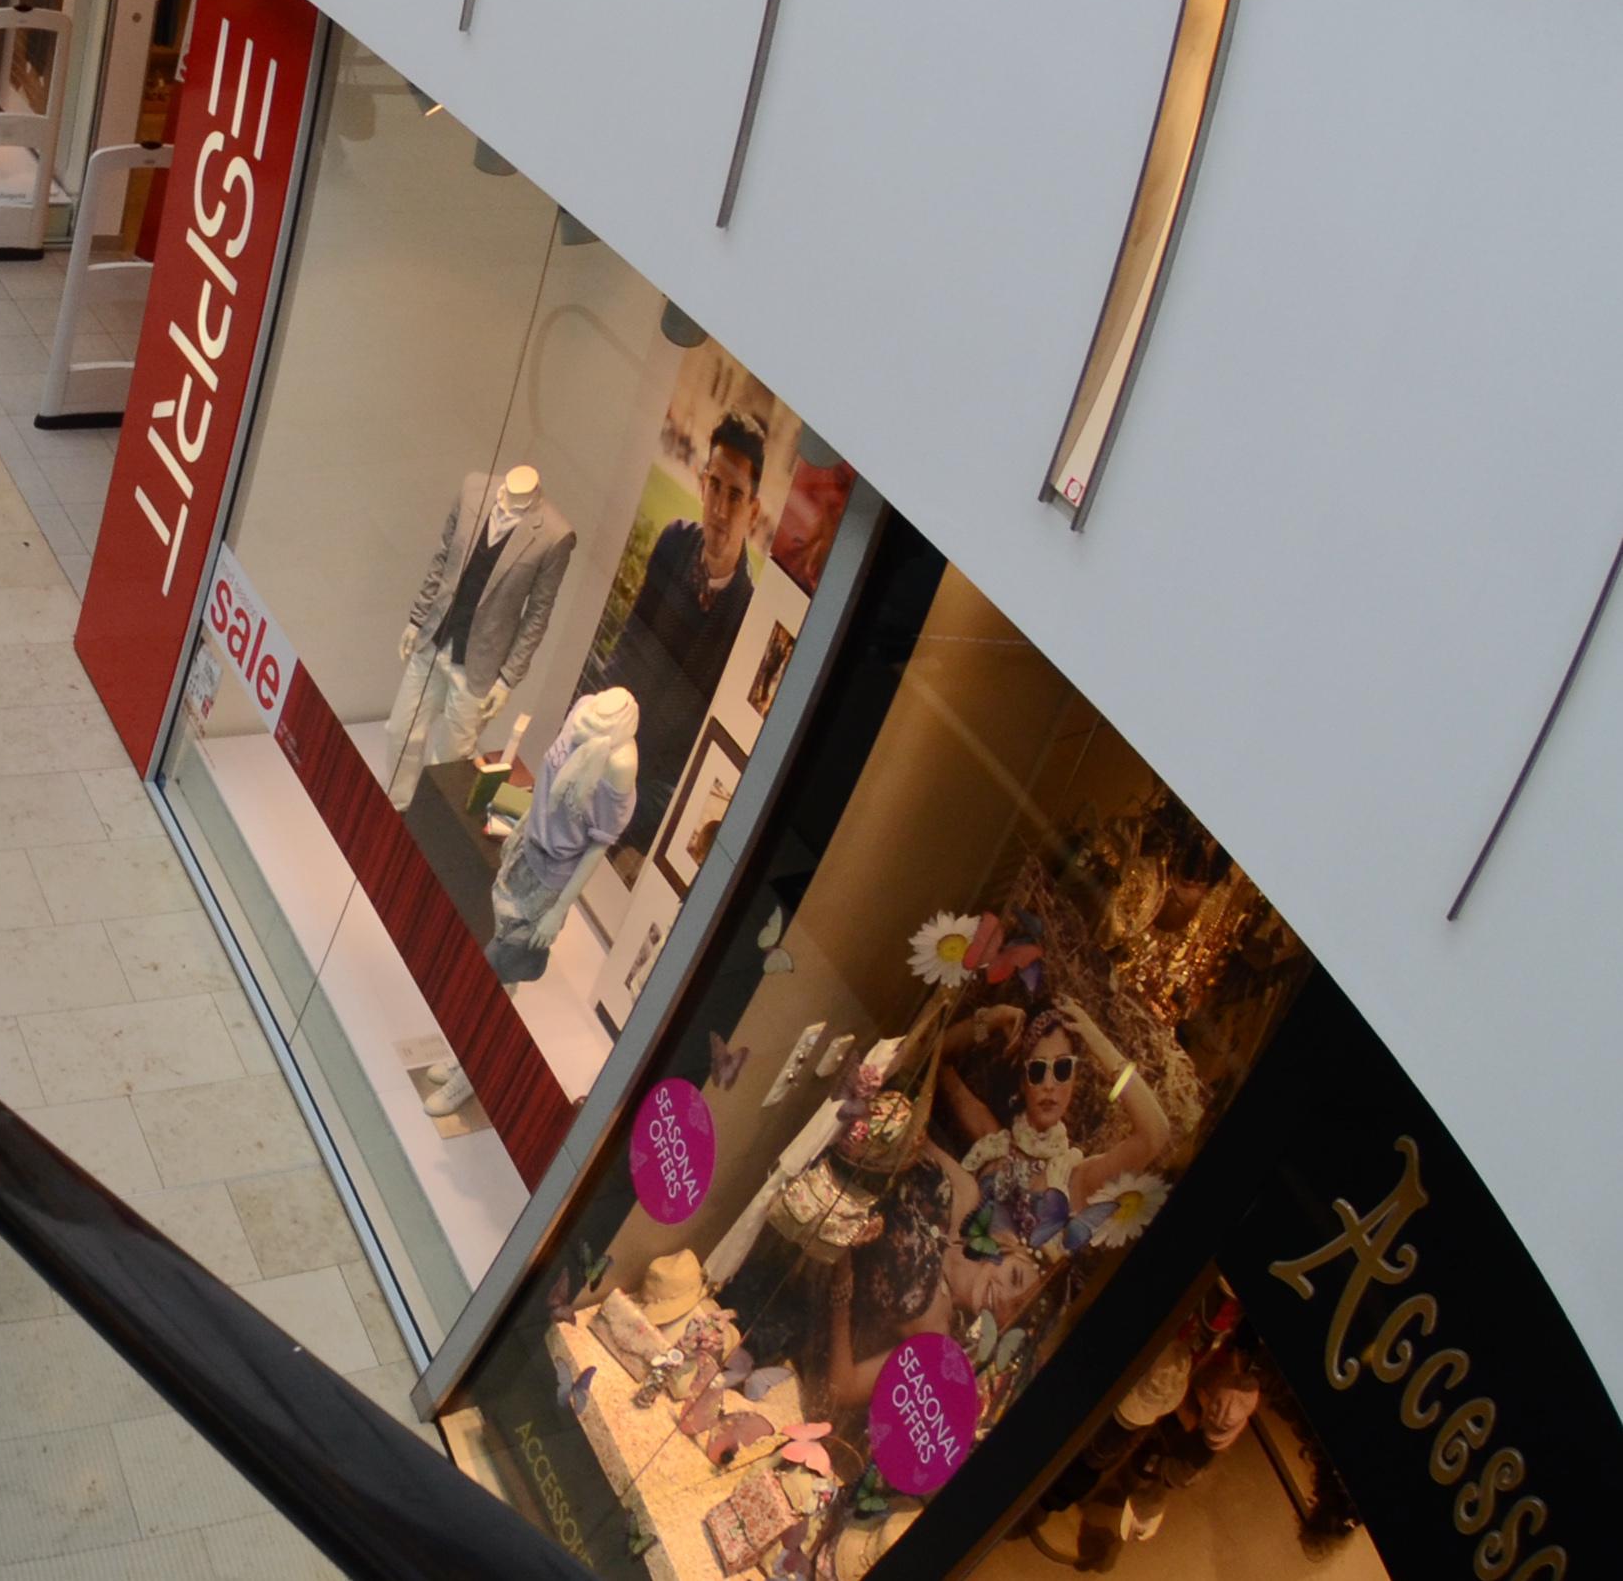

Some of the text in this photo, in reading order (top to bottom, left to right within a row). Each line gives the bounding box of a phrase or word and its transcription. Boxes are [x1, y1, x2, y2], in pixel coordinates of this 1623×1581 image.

[135, 18, 277, 596] ESPRIT
[211, 579, 280, 710] sale
[649, 1120, 681, 1199] OFFERS
[656, 1087, 700, 1206] SEASONAL
[892, 1384, 936, 1464] OFFERS
[898, 1346, 960, 1466] SEASONAL
